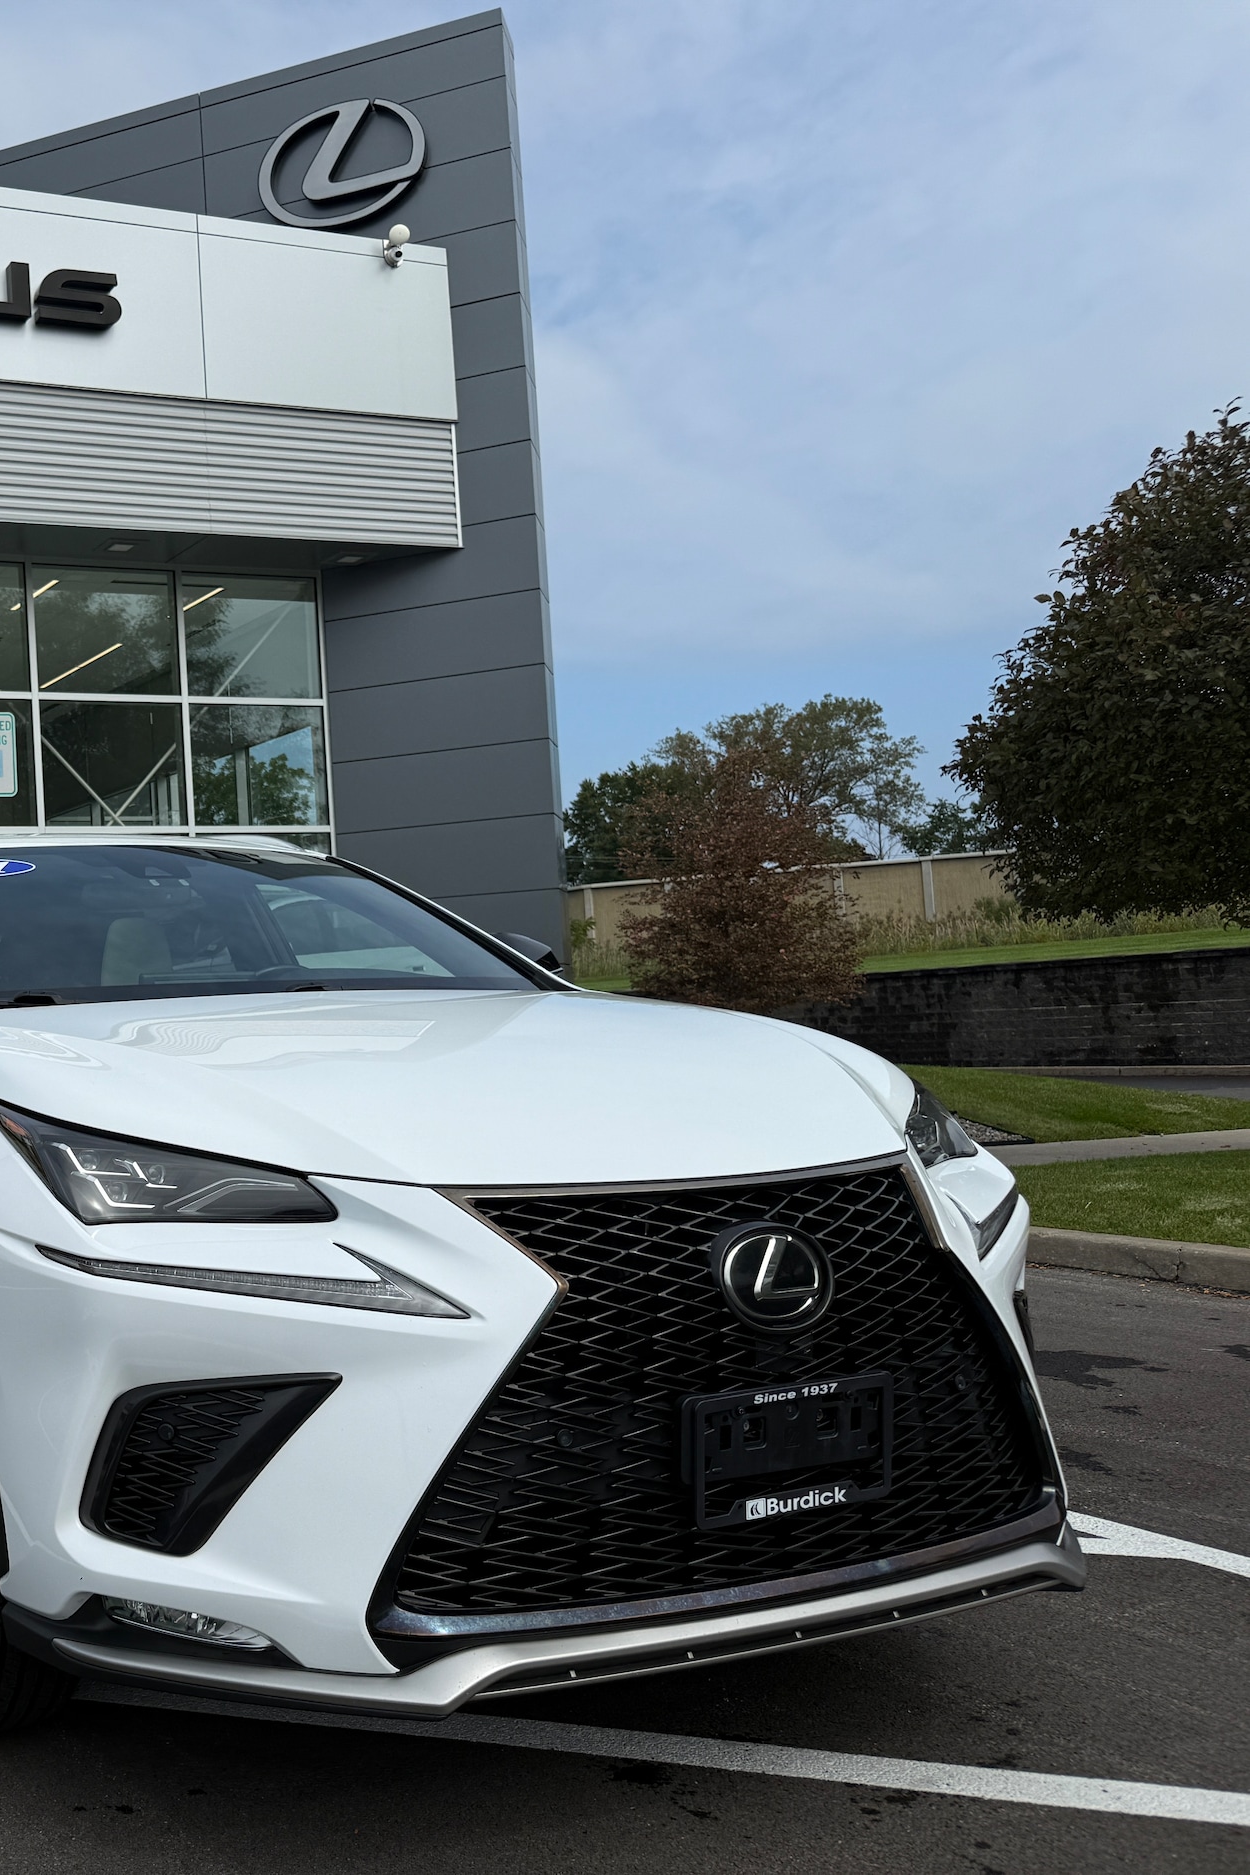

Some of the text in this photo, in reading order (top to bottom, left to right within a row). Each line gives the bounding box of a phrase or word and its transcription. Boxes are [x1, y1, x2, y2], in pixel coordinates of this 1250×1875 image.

[753, 1382, 839, 1405] Since 1937
[766, 1486, 847, 1516] Burdick
